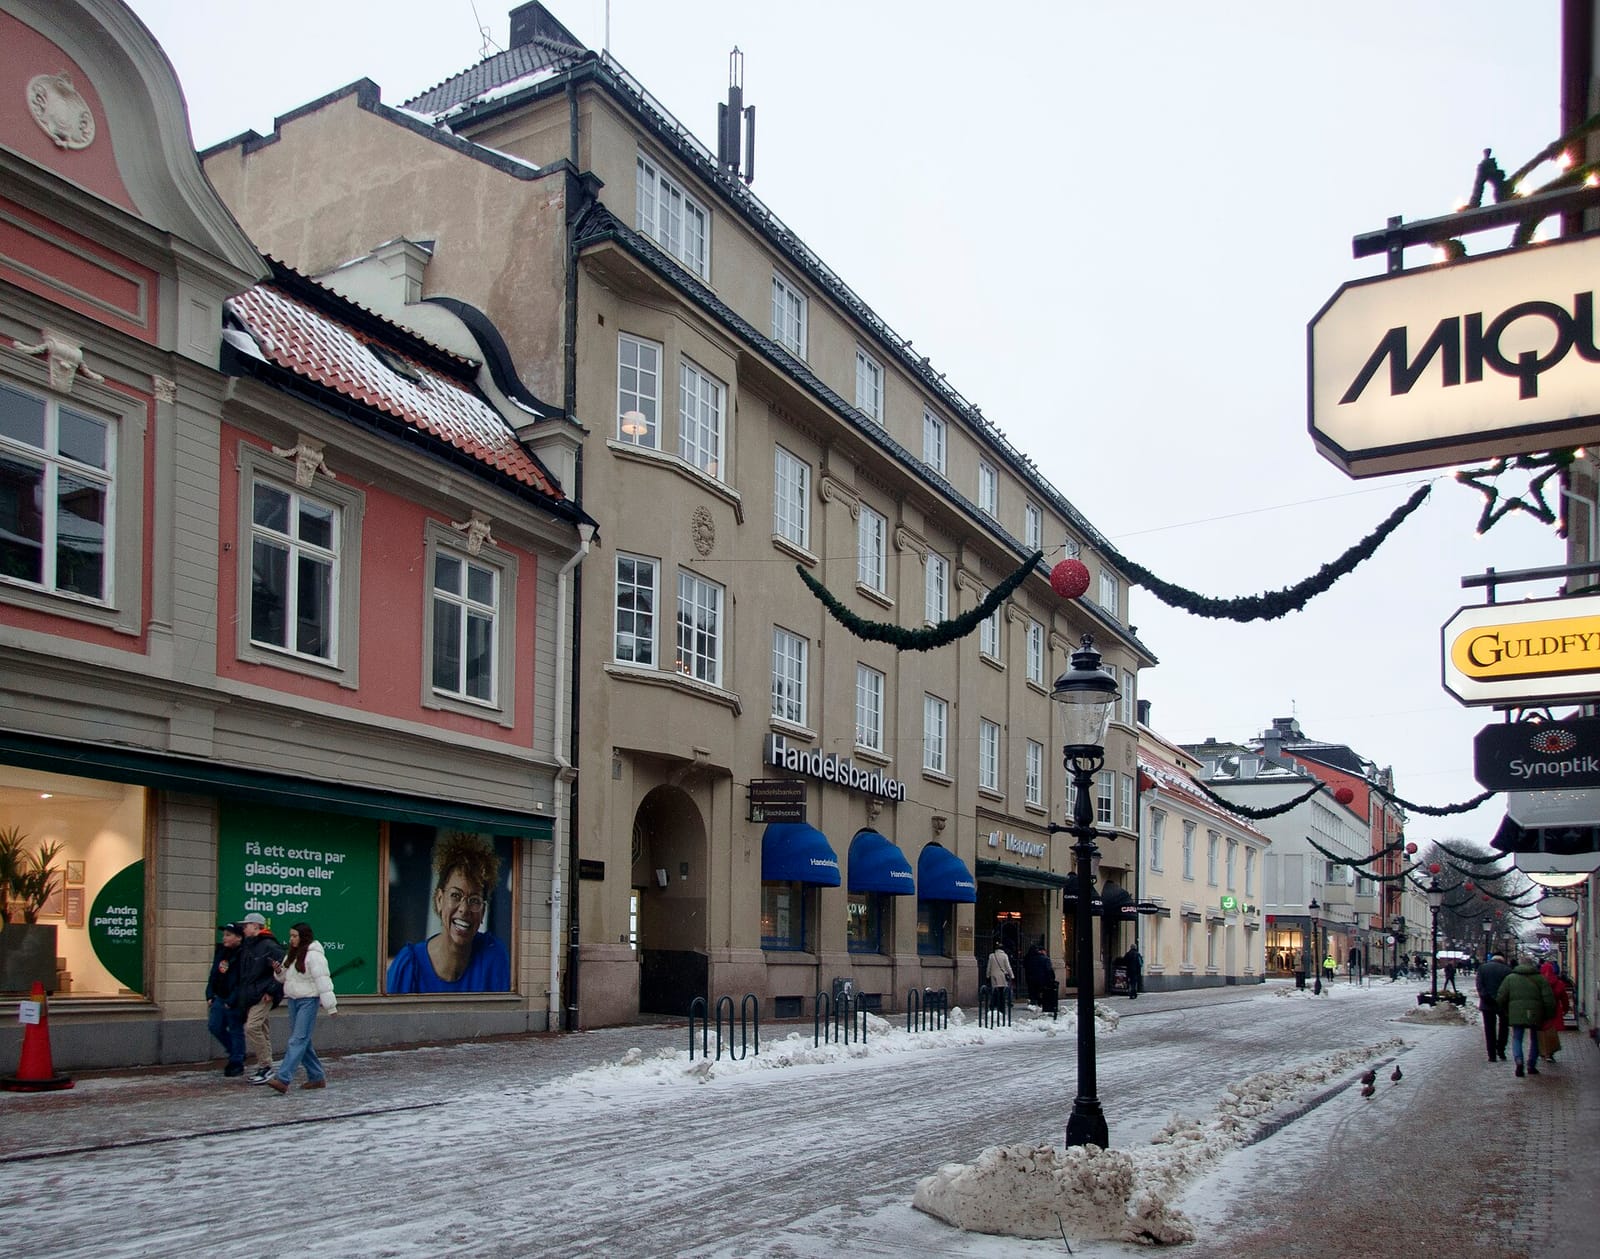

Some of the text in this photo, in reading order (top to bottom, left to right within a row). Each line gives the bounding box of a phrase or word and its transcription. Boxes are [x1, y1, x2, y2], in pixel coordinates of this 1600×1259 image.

[1467, 631, 1600, 668] GULDFY
[771, 732, 907, 802] Handelsbanken
[1509, 756, 1600, 779] Synoptik
[245, 841, 346, 865] Få ett extra par
[245, 860, 335, 880] glasögon eller
[245, 881, 322, 897] uppgradera
[106, 905, 138, 915] Andra
[244, 897, 309, 915] dina glas?
[94, 916, 138, 927] paret på
[107, 926, 138, 938] köpet
[337, 941, 345, 950] kr
